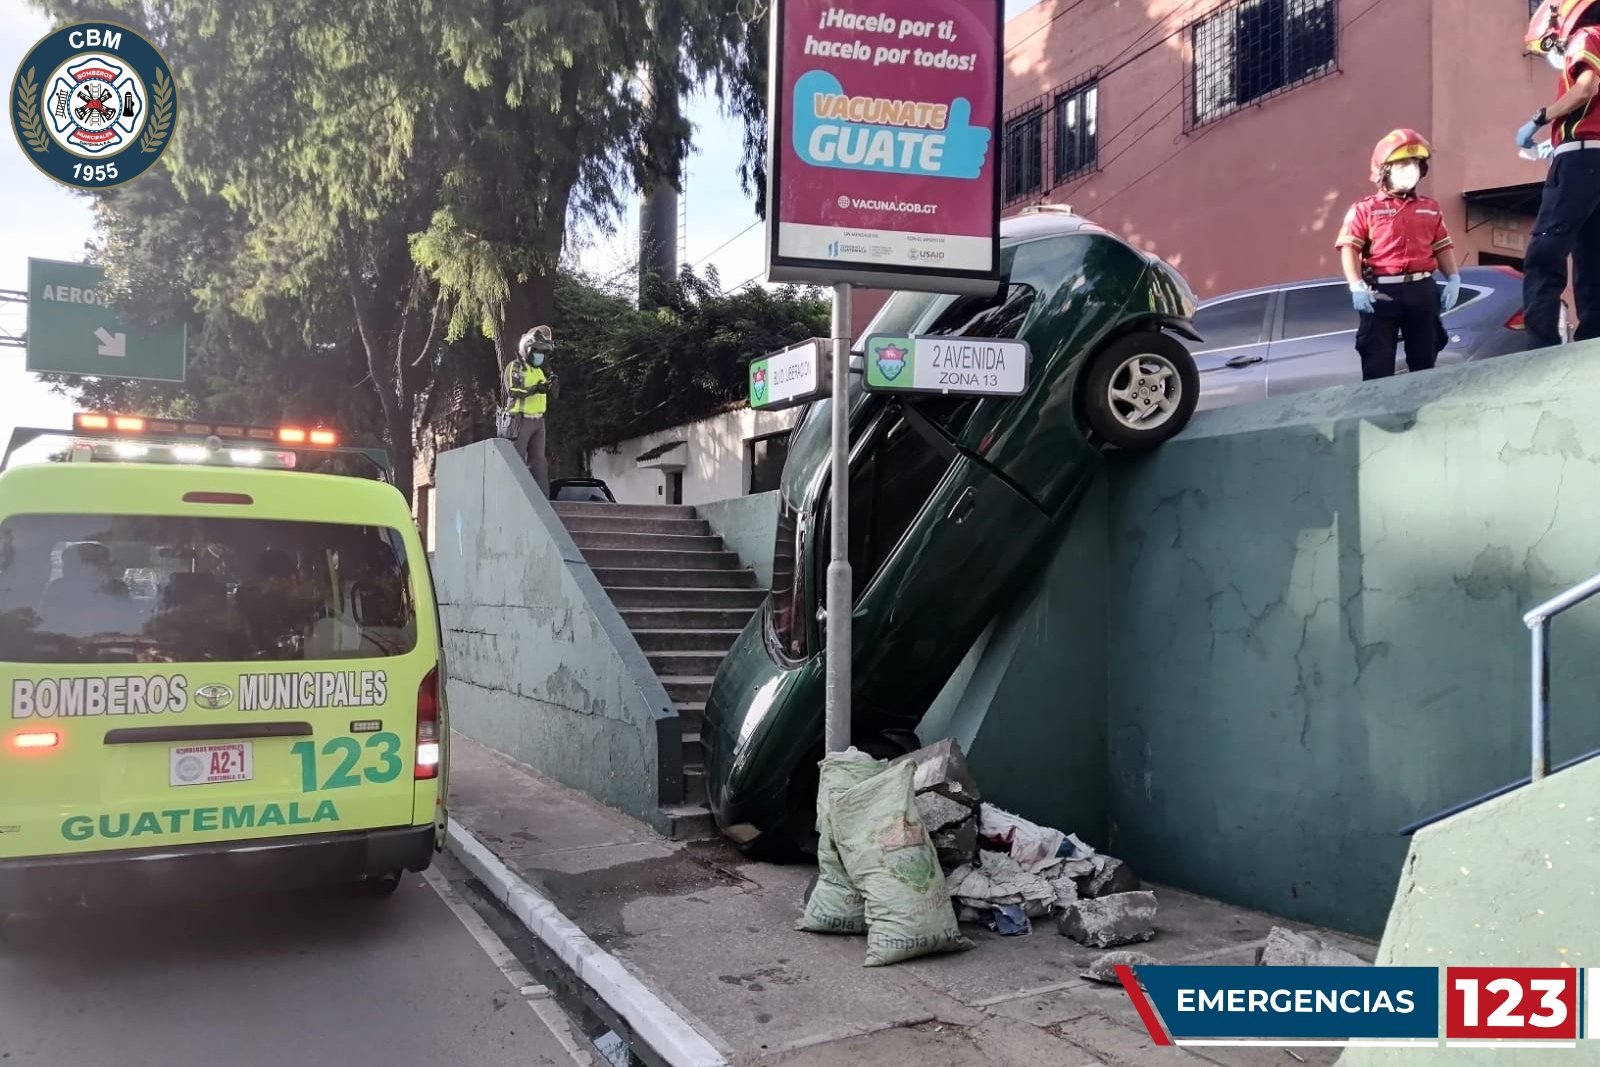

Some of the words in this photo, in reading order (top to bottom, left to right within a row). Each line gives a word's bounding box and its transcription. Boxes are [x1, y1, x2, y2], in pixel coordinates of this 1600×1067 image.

[819, 8, 896, 34] ¡Hacelo
[898, 19, 935, 40] por
[938, 20, 958, 42] ti,
[804, 35, 871, 61] hacelo
[873, 47, 911, 66] por
[913, 48, 976, 71] todos!
[814, 92, 948, 129] VACUNATE
[808, 124, 946, 171] GUATE
[852, 198, 938, 214] VACUNA.GOB.GT
[920, 250, 945, 259] USAID
[43, 284, 104, 306] AERO
[932, 345, 942, 369] 2
[944, 345, 1006, 371] AVENIDA
[938, 372, 979, 386] ZONA
[983, 375, 998, 387] 13
[12, 674, 188, 718] BOMBEROS
[238, 670, 388, 711] MUNICIPALES
[210, 751, 245, 774] A2-1
[290, 731, 402, 793] 123
[60, 800, 340, 842] GUATEMALA
[877, 933, 928, 951] Limpia
[932, 934, 941, 947] y
